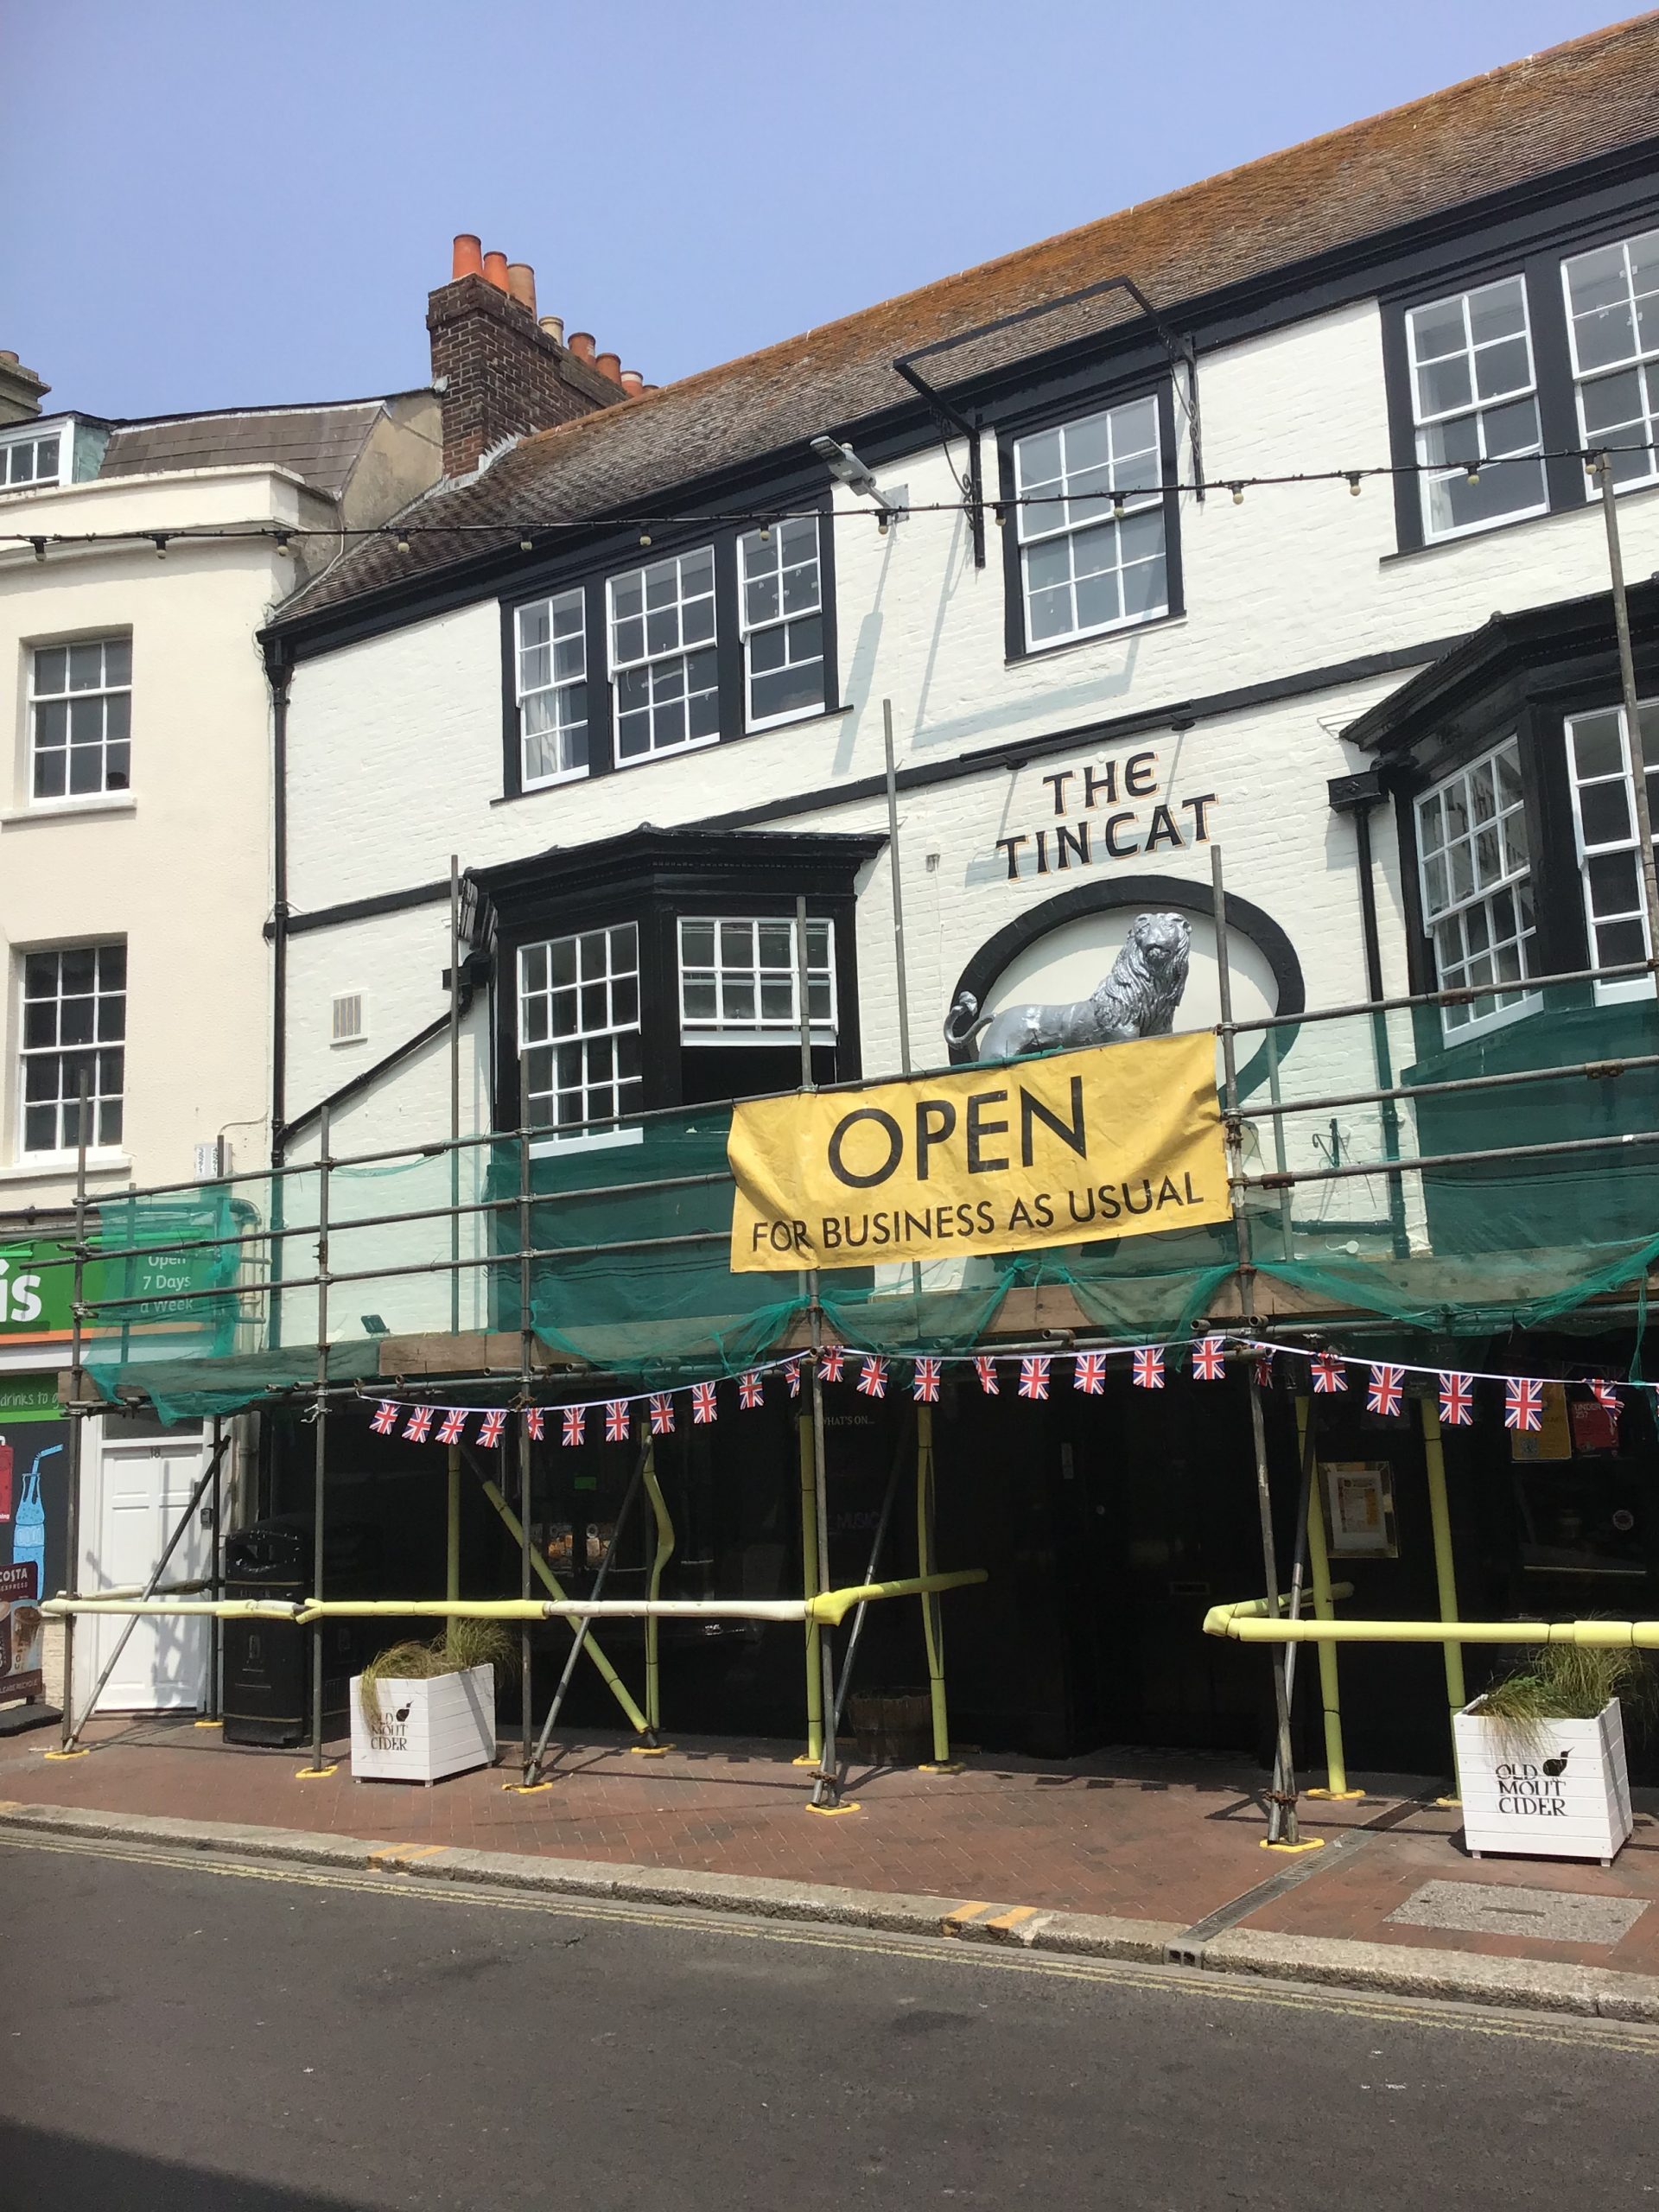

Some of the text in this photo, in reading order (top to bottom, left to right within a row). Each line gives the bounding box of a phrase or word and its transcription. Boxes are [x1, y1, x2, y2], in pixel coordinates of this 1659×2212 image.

[1042, 752, 1160, 816] THE
[827, 1075, 1087, 1188] OPEN
[753, 1172, 1204, 1252] FOR BUSINESS AS USUAL
[143, 1274, 192, 1292] 7 Days
[140, 1302, 149, 1313] a
[0, 1393, 35, 1407] drinks
[37, 1391, 48, 1405] to
[149, 1446, 162, 1459] 18
[371, 1737, 409, 1751] CIDER
[1496, 1764, 1538, 1780] OLD
[1497, 1780, 1567, 1796] MOUT
[1498, 1797, 1568, 1816] CIDER
